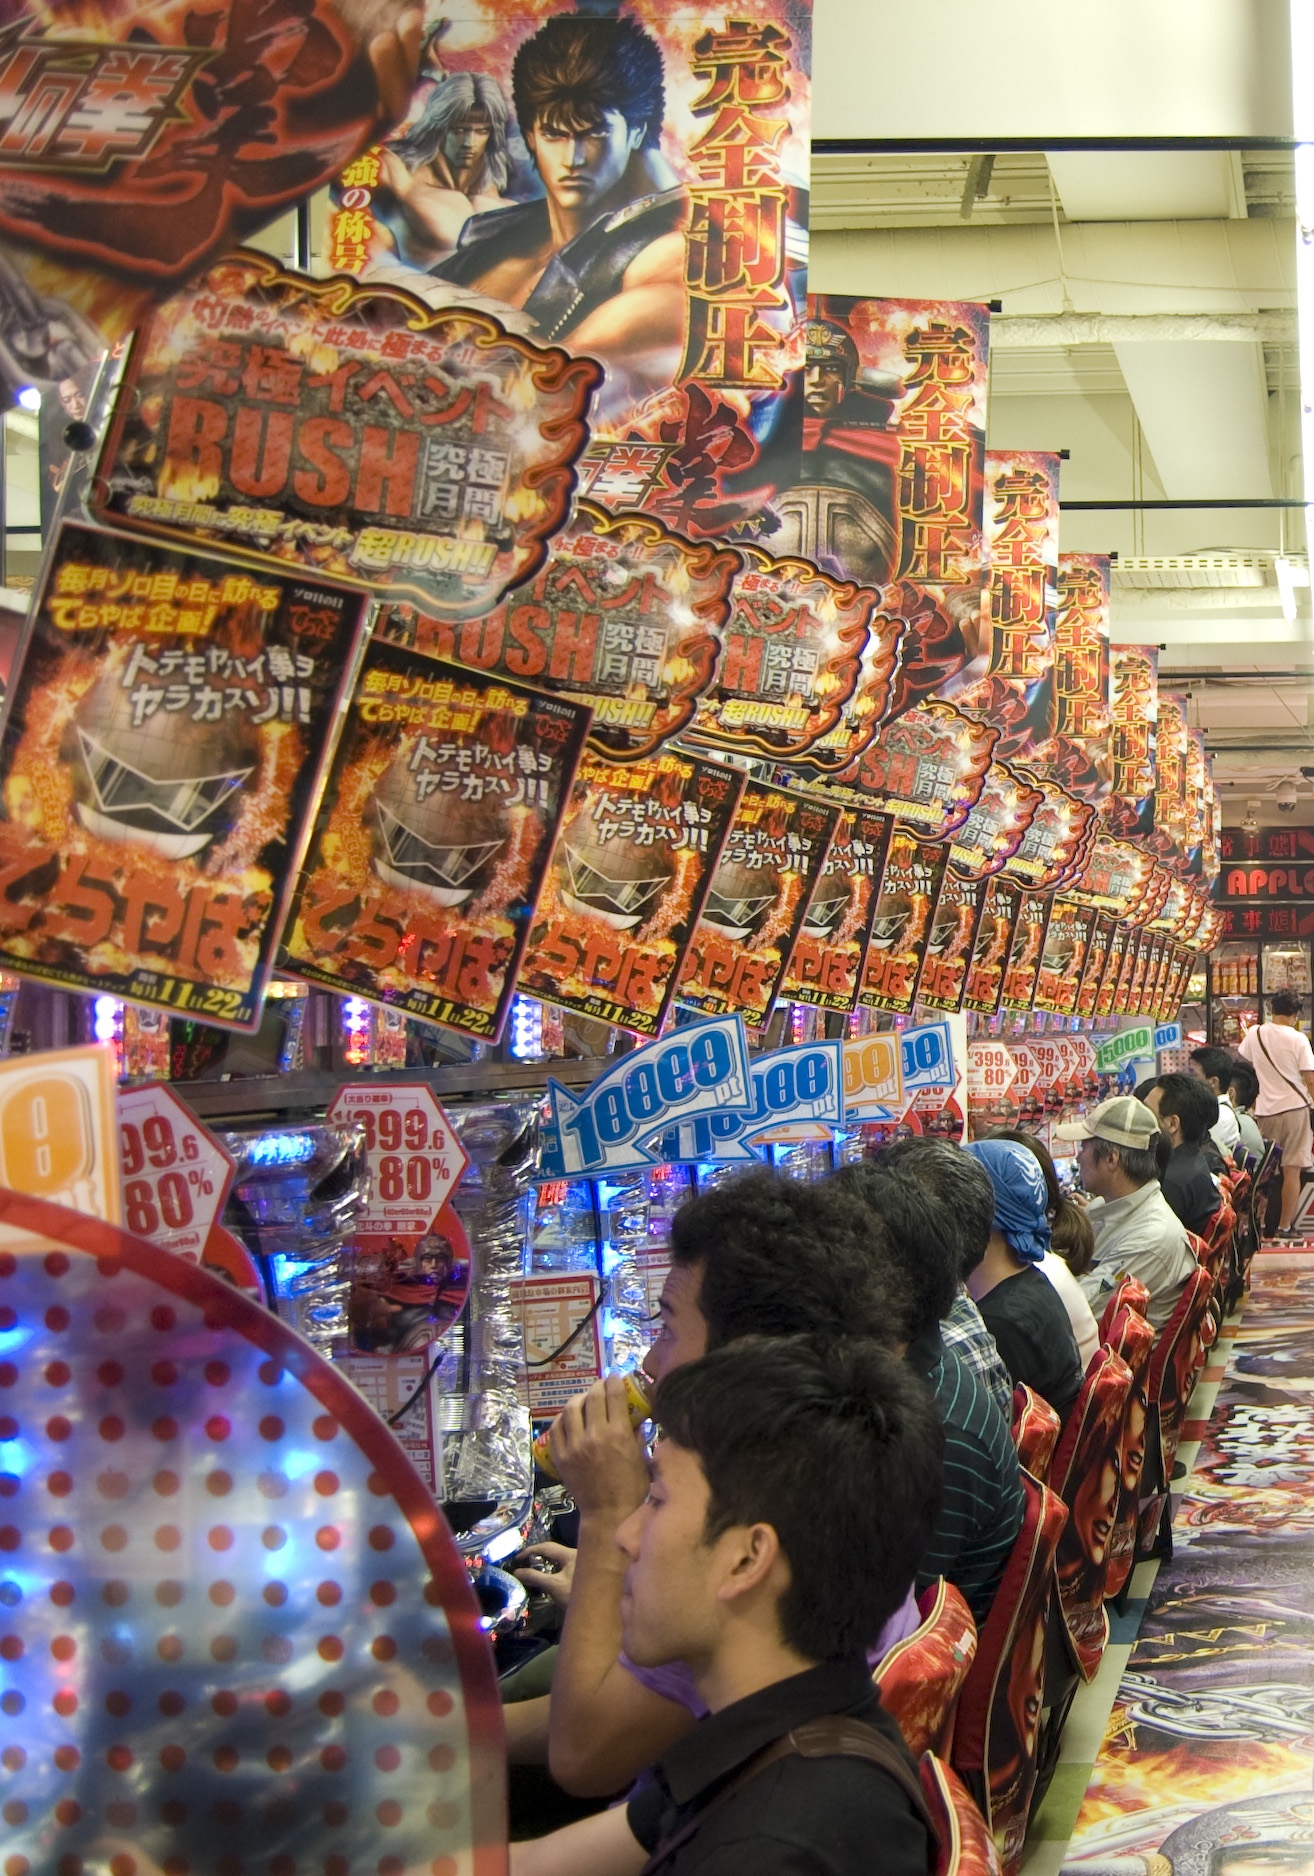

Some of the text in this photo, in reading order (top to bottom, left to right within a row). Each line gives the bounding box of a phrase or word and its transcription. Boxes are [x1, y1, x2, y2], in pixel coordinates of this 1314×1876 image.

[673, 16, 791, 388] 完全制圧
[178, 334, 511, 435] 究極イベント
[160, 394, 422, 521] RUSH
[426, 442, 508, 486] 究極
[895, 323, 976, 585] 完全制圧
[424, 482, 503, 528] 月間
[56, 561, 282, 612] 毎月ゾロ目の日に訪れる
[987, 468, 1050, 679] 完全制圧
[50, 600, 213, 637] てらやば 企画!
[606, 622, 667, 654] 究極
[121, 642, 314, 687] トテモヤバイ事ヲ
[600, 653, 660, 687] 月間
[768, 644, 820, 673] 究極
[1055, 567, 1103, 740] 完全制圧
[362, 669, 528, 718] 毎月ゾロ目の日に訪れる
[765, 670, 814, 697] 月間
[130, 683, 313, 731] ヤラカスゾ!!
[356, 697, 481, 734] てらやば 企画!
[409, 741, 553, 778] トテモヤバイ事ヲ
[414, 770, 548, 807] ヤラカスゾ!!
[596, 791, 712, 826] トテモヤバイ事ヲ
[598, 818, 708, 853] ヤラカスゾ!!
[563, 1028, 741, 1168] 10000 pt
[813, 1094, 835, 1117] pt
[379, 1156, 449, 1200] 80%
